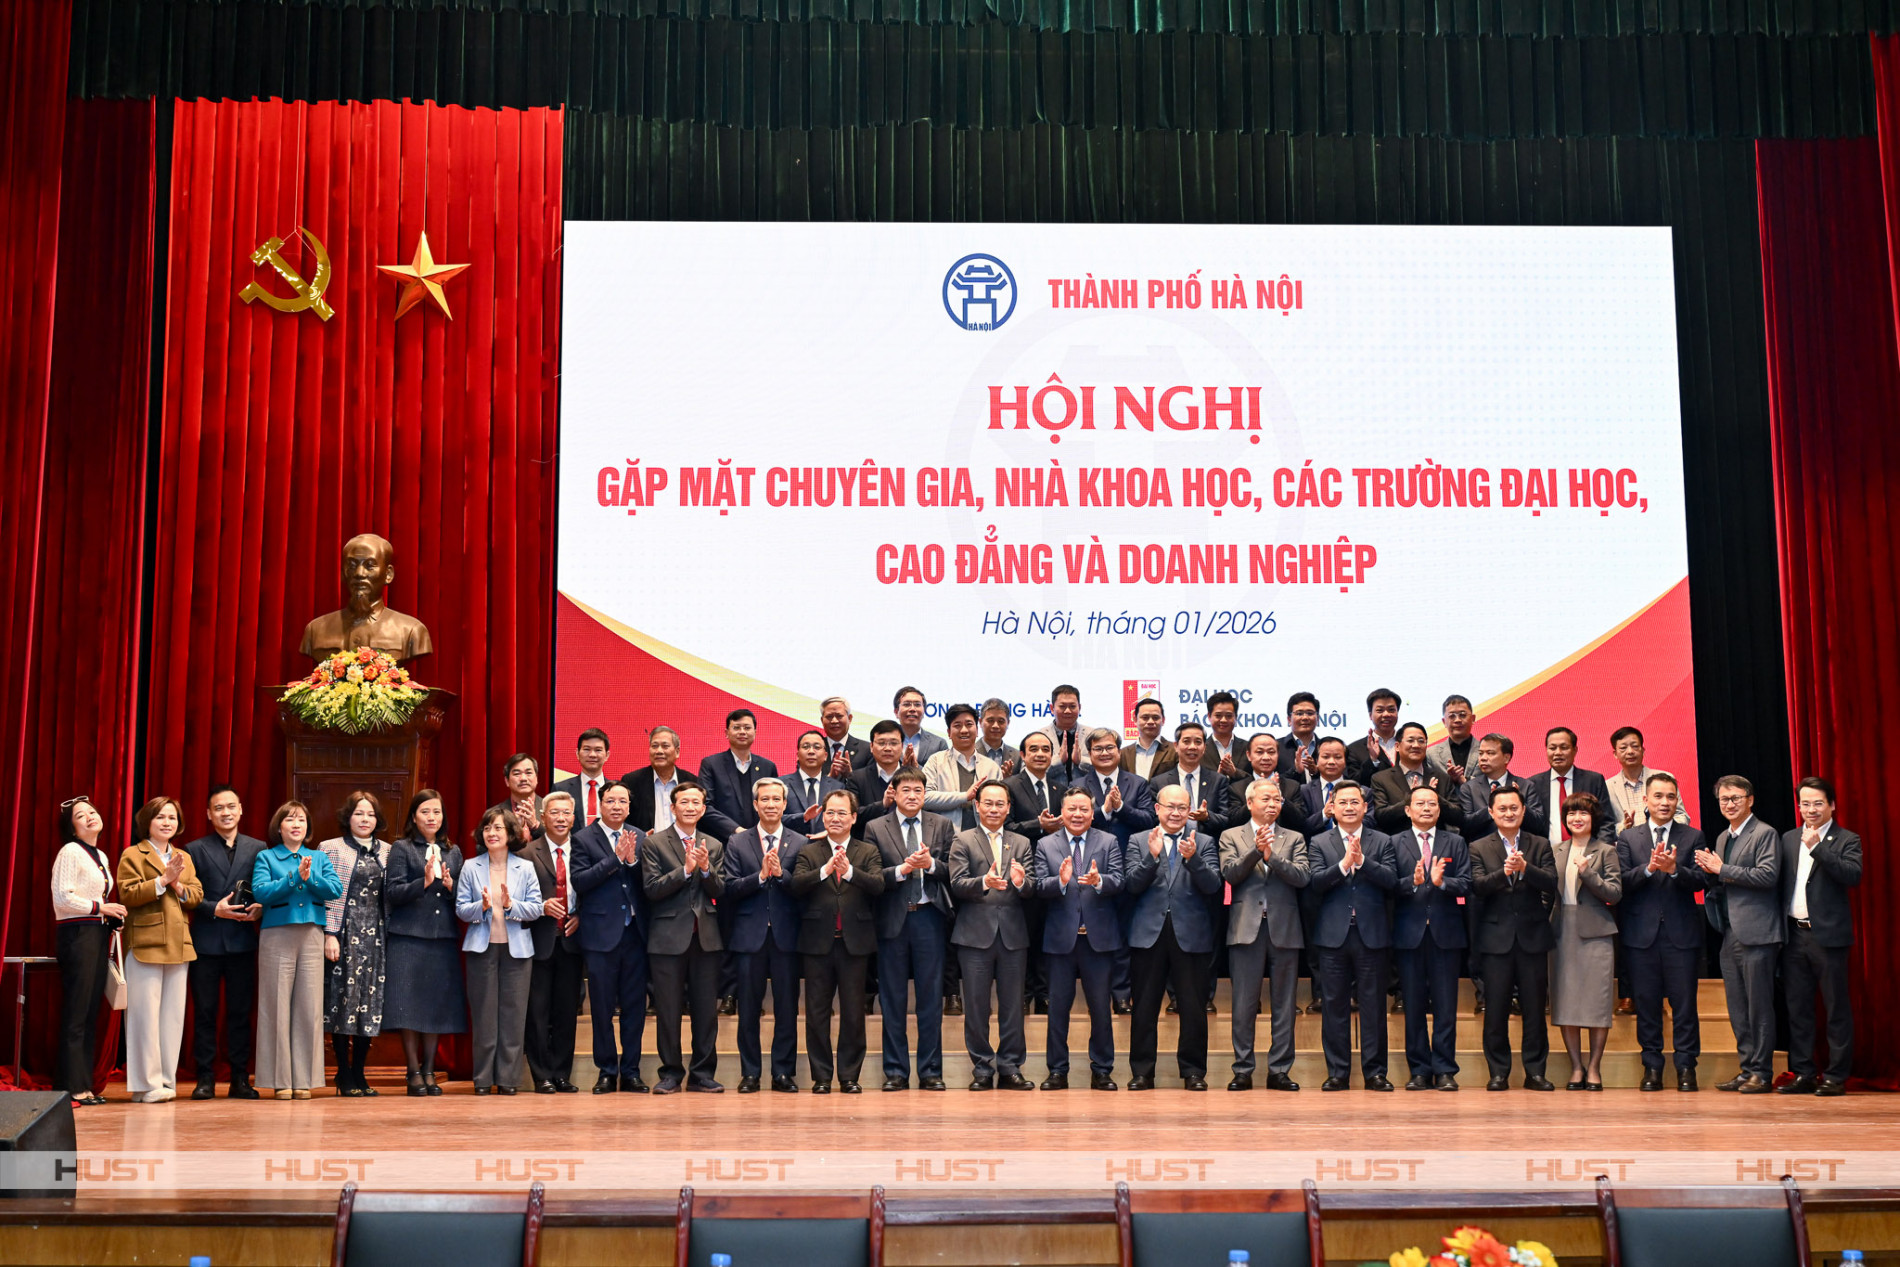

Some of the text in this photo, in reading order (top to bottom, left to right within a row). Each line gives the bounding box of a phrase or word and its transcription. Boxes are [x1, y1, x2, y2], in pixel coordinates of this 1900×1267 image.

[1048, 269, 1303, 316] THÀNH PHỐ HÀ NỘI
[968, 322, 978, 331] HÀ
[988, 371, 1262, 444] HỘI NGHỊ
[598, 458, 1648, 516] GẶP MẶT CHUYÊN GIA, NHÀ KHOA HỌC, CÁC TRƯỜNG ĐẠI HỌC,
[877, 524, 1377, 593] CAO ĐẲNG VÀ DOANH NGHIỆP
[982, 610, 1277, 640] Hà Nội, tháng 01/2026
[1178, 689, 1208, 706] ĐẠI
[1180, 709, 1212, 728] BÁC
[1234, 713, 1282, 728] KHOA
[1317, 710, 1347, 731] NỘI
